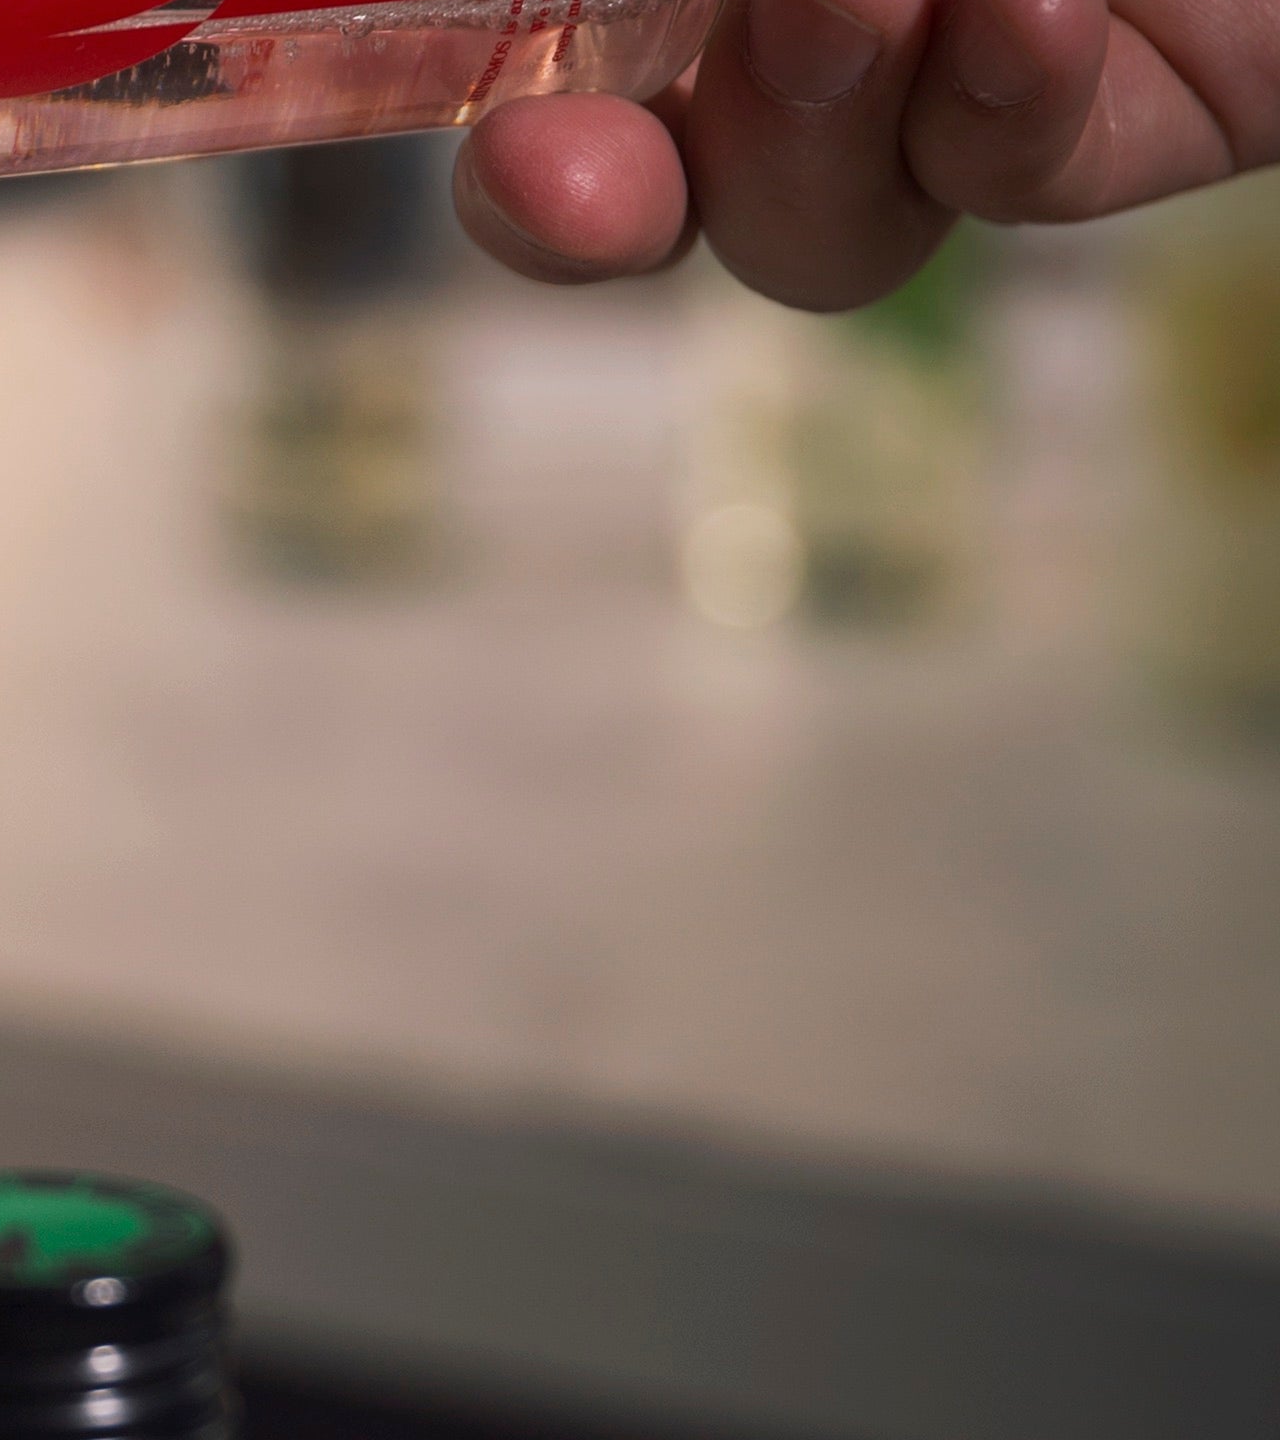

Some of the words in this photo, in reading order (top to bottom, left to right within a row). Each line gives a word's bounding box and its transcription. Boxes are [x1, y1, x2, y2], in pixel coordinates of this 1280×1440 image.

[531, 6, 549, 34] We
[467, 40, 512, 102] HINEMOS
[503, 19, 516, 36] is
[553, 22, 576, 63] every
